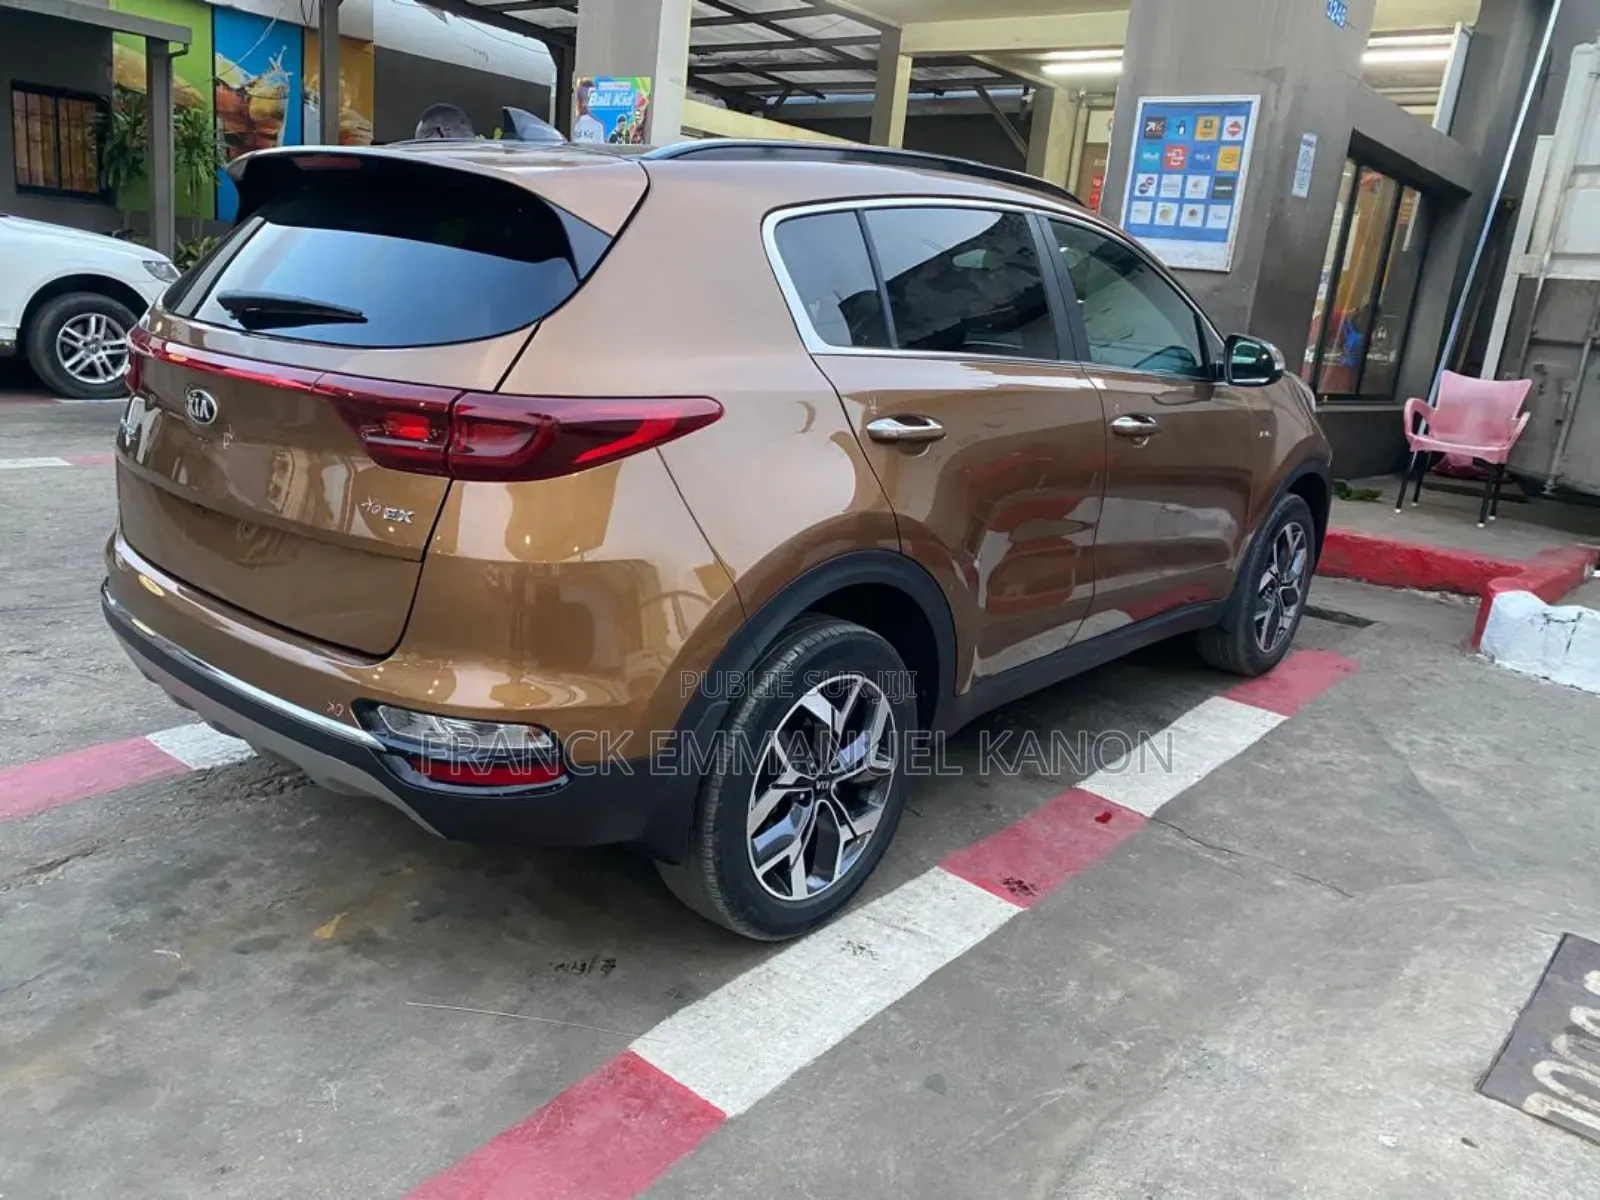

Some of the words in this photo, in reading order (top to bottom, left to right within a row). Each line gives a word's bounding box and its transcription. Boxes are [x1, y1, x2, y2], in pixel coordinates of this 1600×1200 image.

[588, 91, 611, 107] Ball
[612, 91, 634, 107] Kid
[188, 395, 210, 419] KIA
[383, 507, 415, 524] EX
